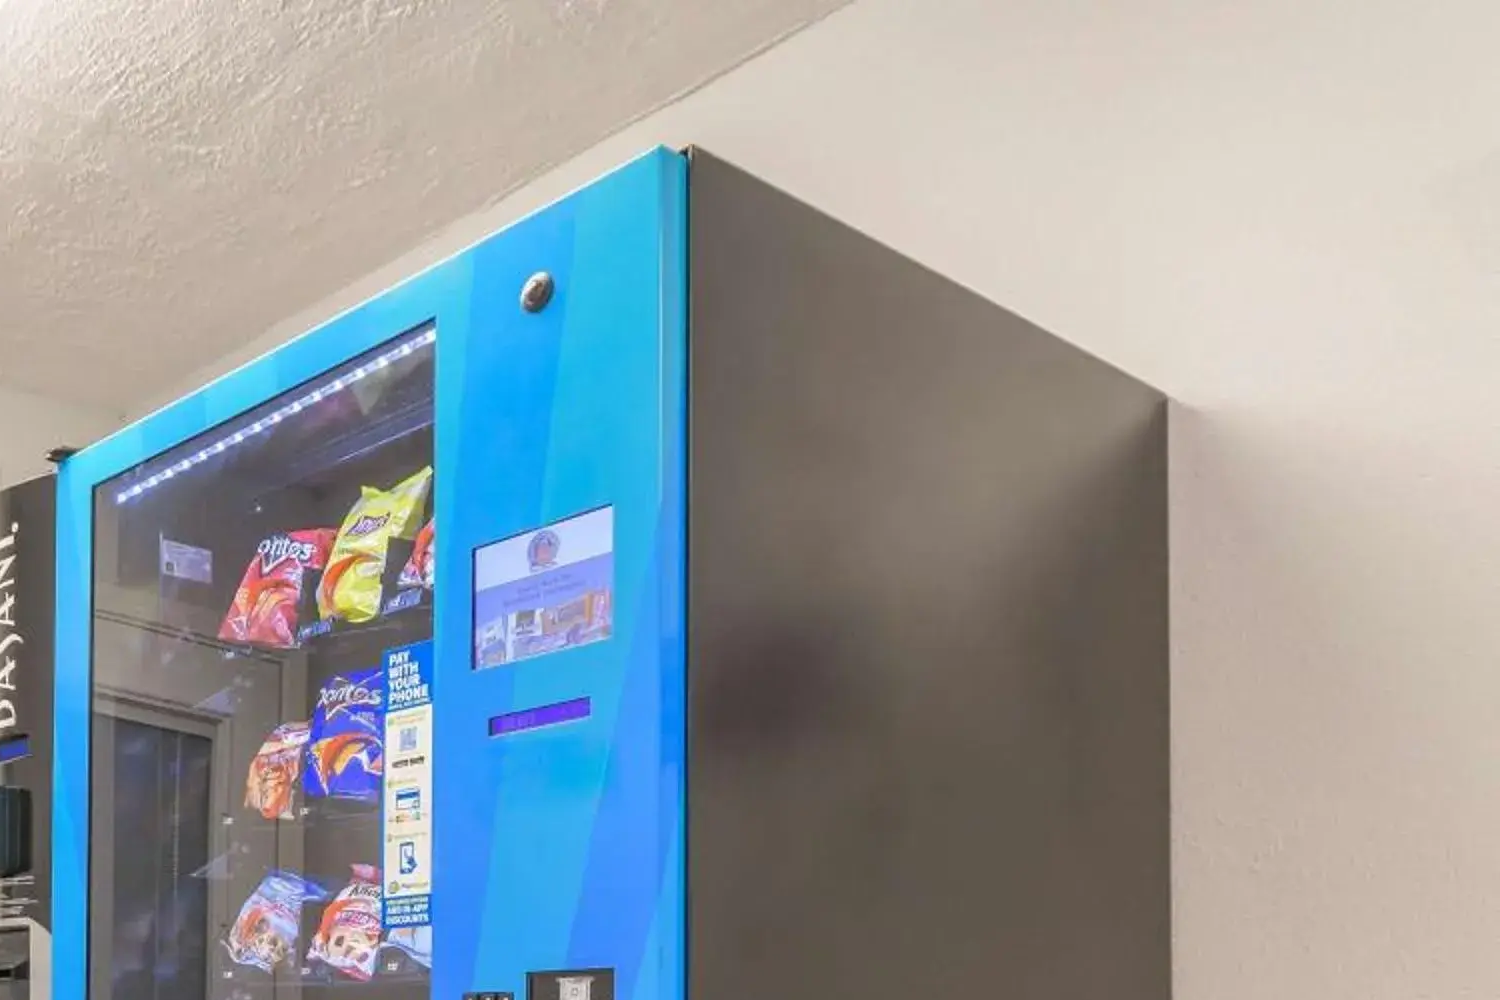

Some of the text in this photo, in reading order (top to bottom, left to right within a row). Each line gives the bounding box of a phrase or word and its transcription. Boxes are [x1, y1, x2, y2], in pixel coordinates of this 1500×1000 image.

[257, 535, 315, 560] oritos
[388, 651, 410, 666] PAY
[388, 662, 419, 679] WITH
[388, 674, 421, 691] YOUR
[388, 684, 429, 704] PHONE
